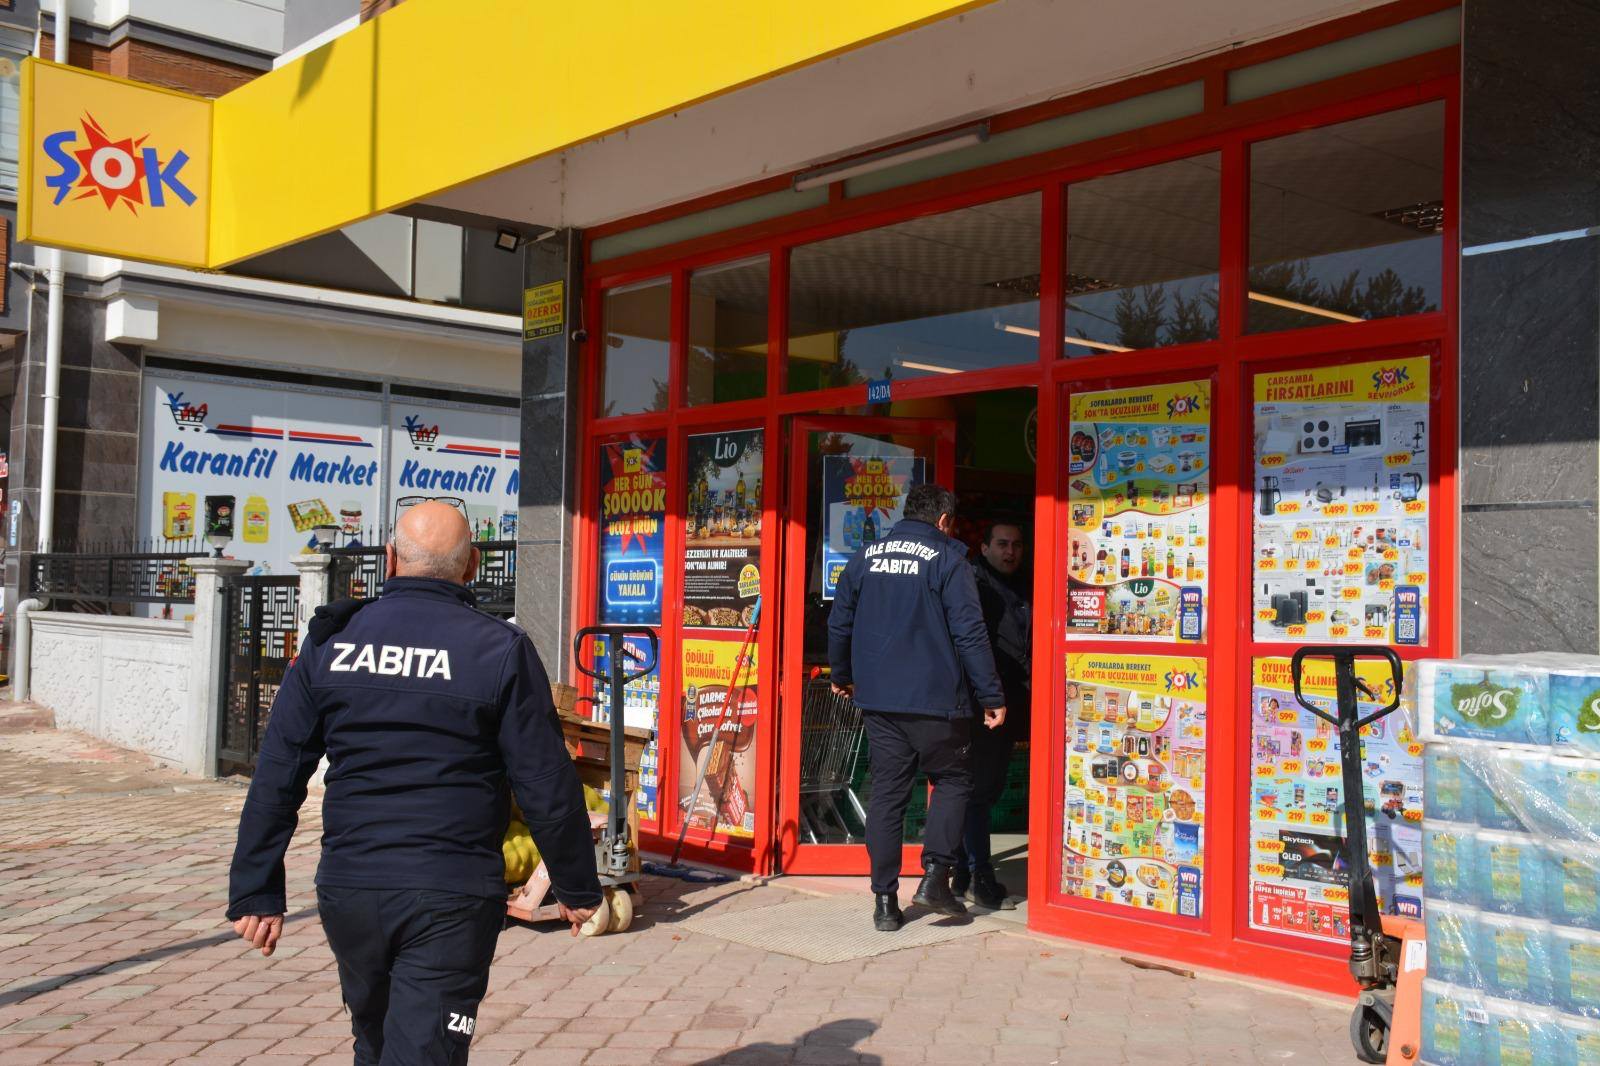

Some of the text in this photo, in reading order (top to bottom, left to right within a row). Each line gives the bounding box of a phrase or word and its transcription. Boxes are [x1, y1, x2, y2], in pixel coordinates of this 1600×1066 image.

[43, 130, 198, 207] ŞOK
[1266, 379, 1354, 401] FIRSATLARINI
[1166, 394, 1201, 420] ŞOK
[715, 437, 738, 460] Lio
[159, 441, 378, 487] Karanfil Market
[399, 459, 497, 494] Karanfil
[614, 472, 653, 491] HER GÜN
[633, 515, 658, 535] ÜRÜN
[711, 549, 719, 558] VE
[870, 558, 919, 575] ZABITA
[618, 583, 646, 597] YAKALA
[1134, 583, 1148, 594] Lio
[330, 642, 452, 681] ZABITA
[685, 648, 714, 664] ÖDÜLLÜ
[685, 664, 731, 680] ÜRÜNÜMÜZÜ
[1088, 661, 1125, 670] SOFRALARDA
[1262, 662, 1306, 674] OYUNCK
[1107, 671, 1138, 681] UCUZLUK
[1140, 673, 1157, 682] VAR!
[1164, 671, 1199, 693] ŞOK
[699, 691, 733, 705] KARME
[1458, 690, 1515, 719] Sofia
[1282, 835, 1315, 845] Skytech
[1282, 851, 1302, 863] QLED
